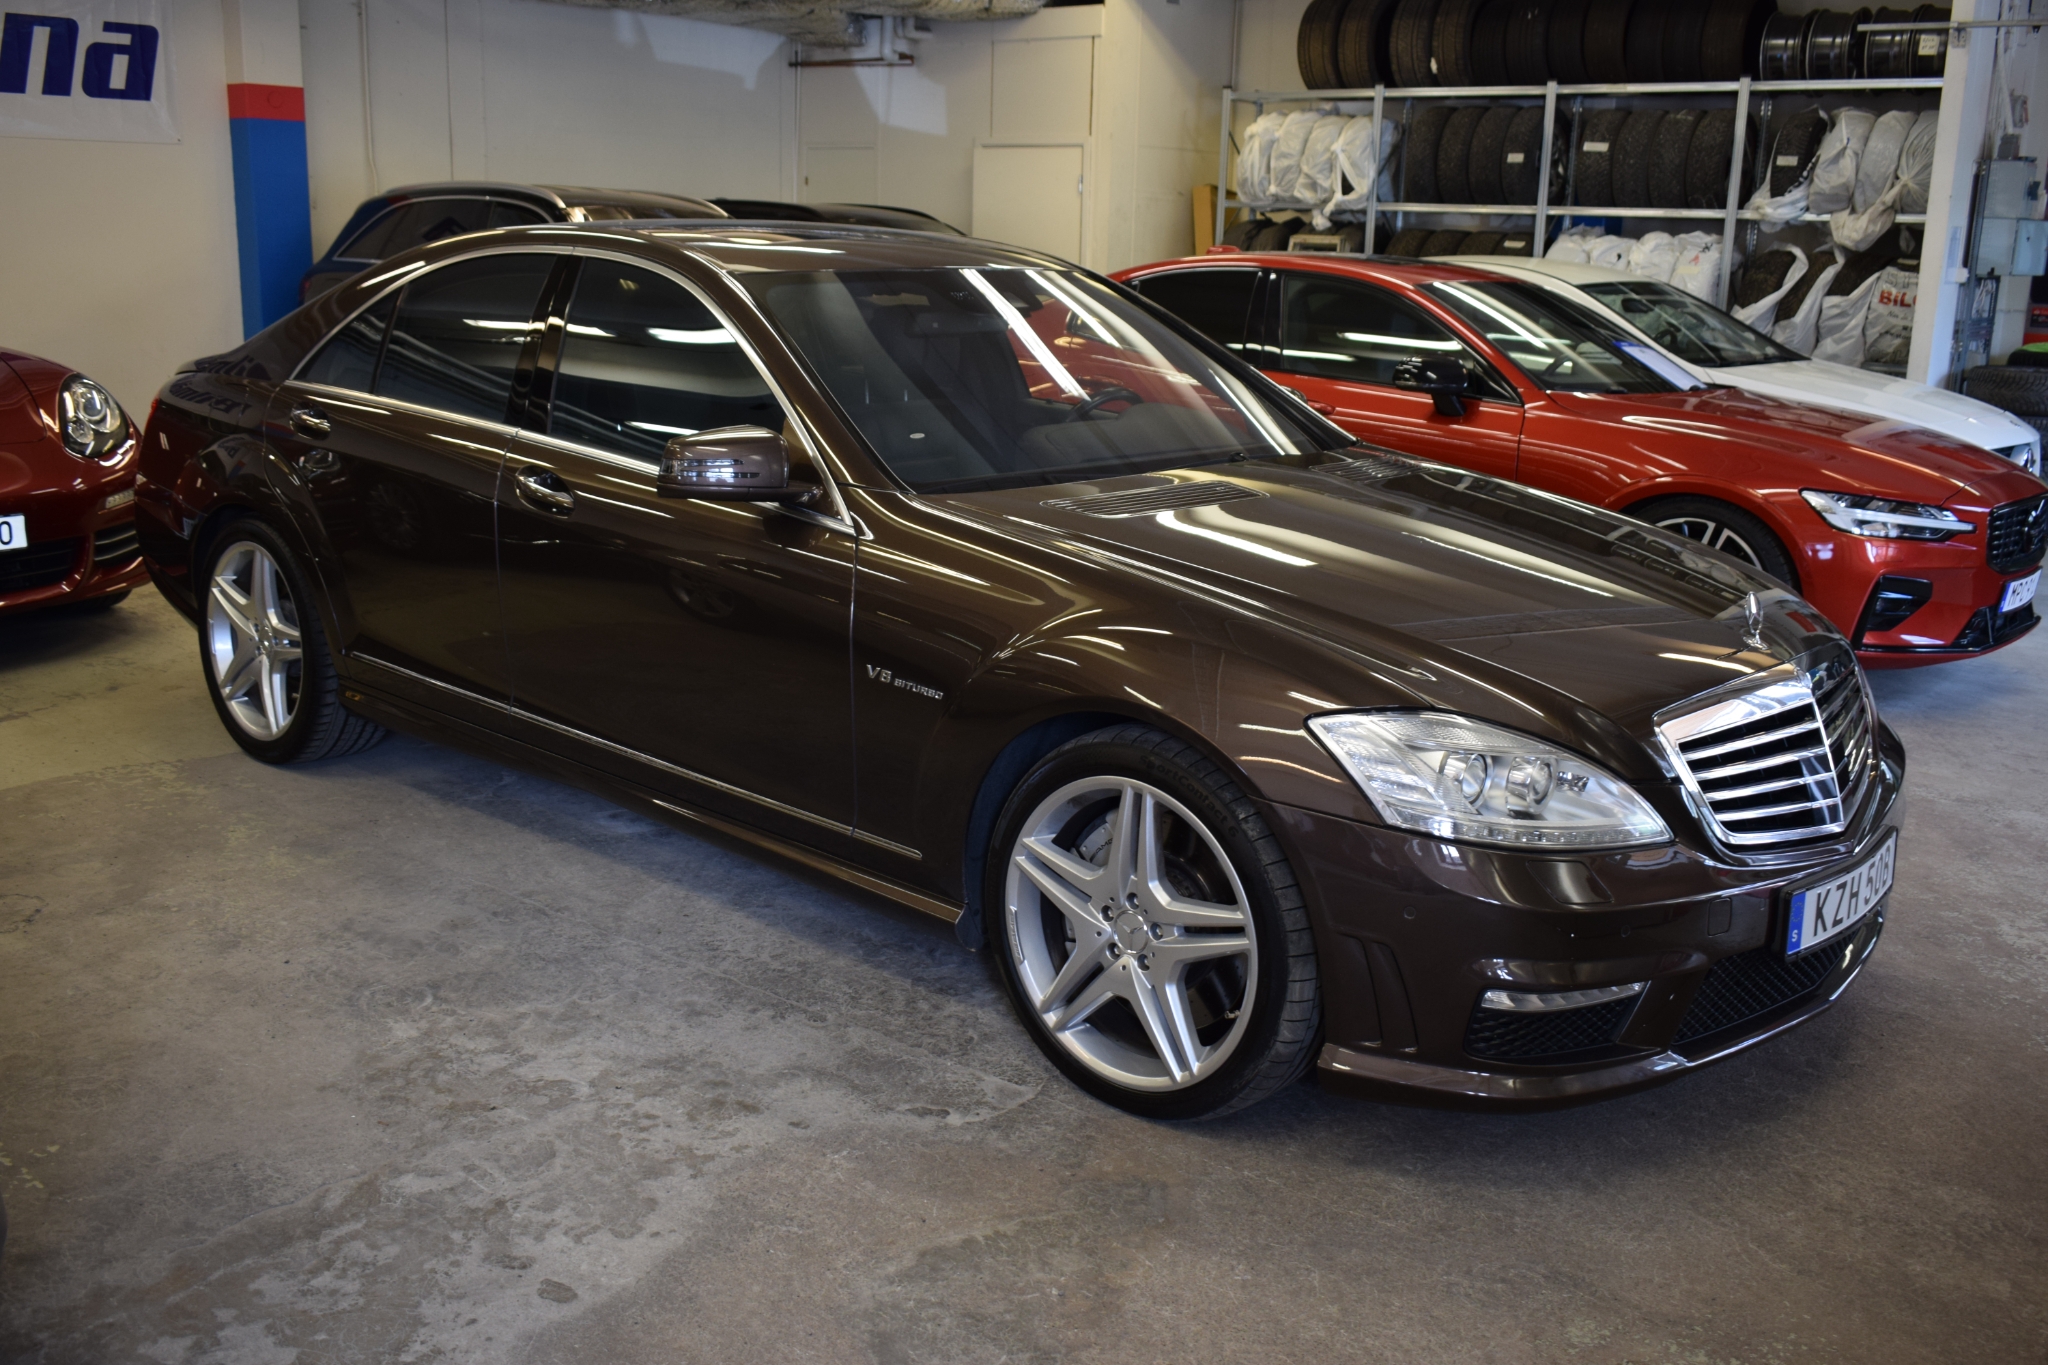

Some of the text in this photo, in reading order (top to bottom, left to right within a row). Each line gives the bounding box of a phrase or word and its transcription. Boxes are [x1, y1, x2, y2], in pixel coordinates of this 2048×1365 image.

[0, 12, 159, 102] na
[866, 664, 944, 700] V8 BITURBO
[1139, 754, 1229, 824] SportContact
[1791, 929, 1798, 942] S
[1813, 872, 1862, 937] KZH
